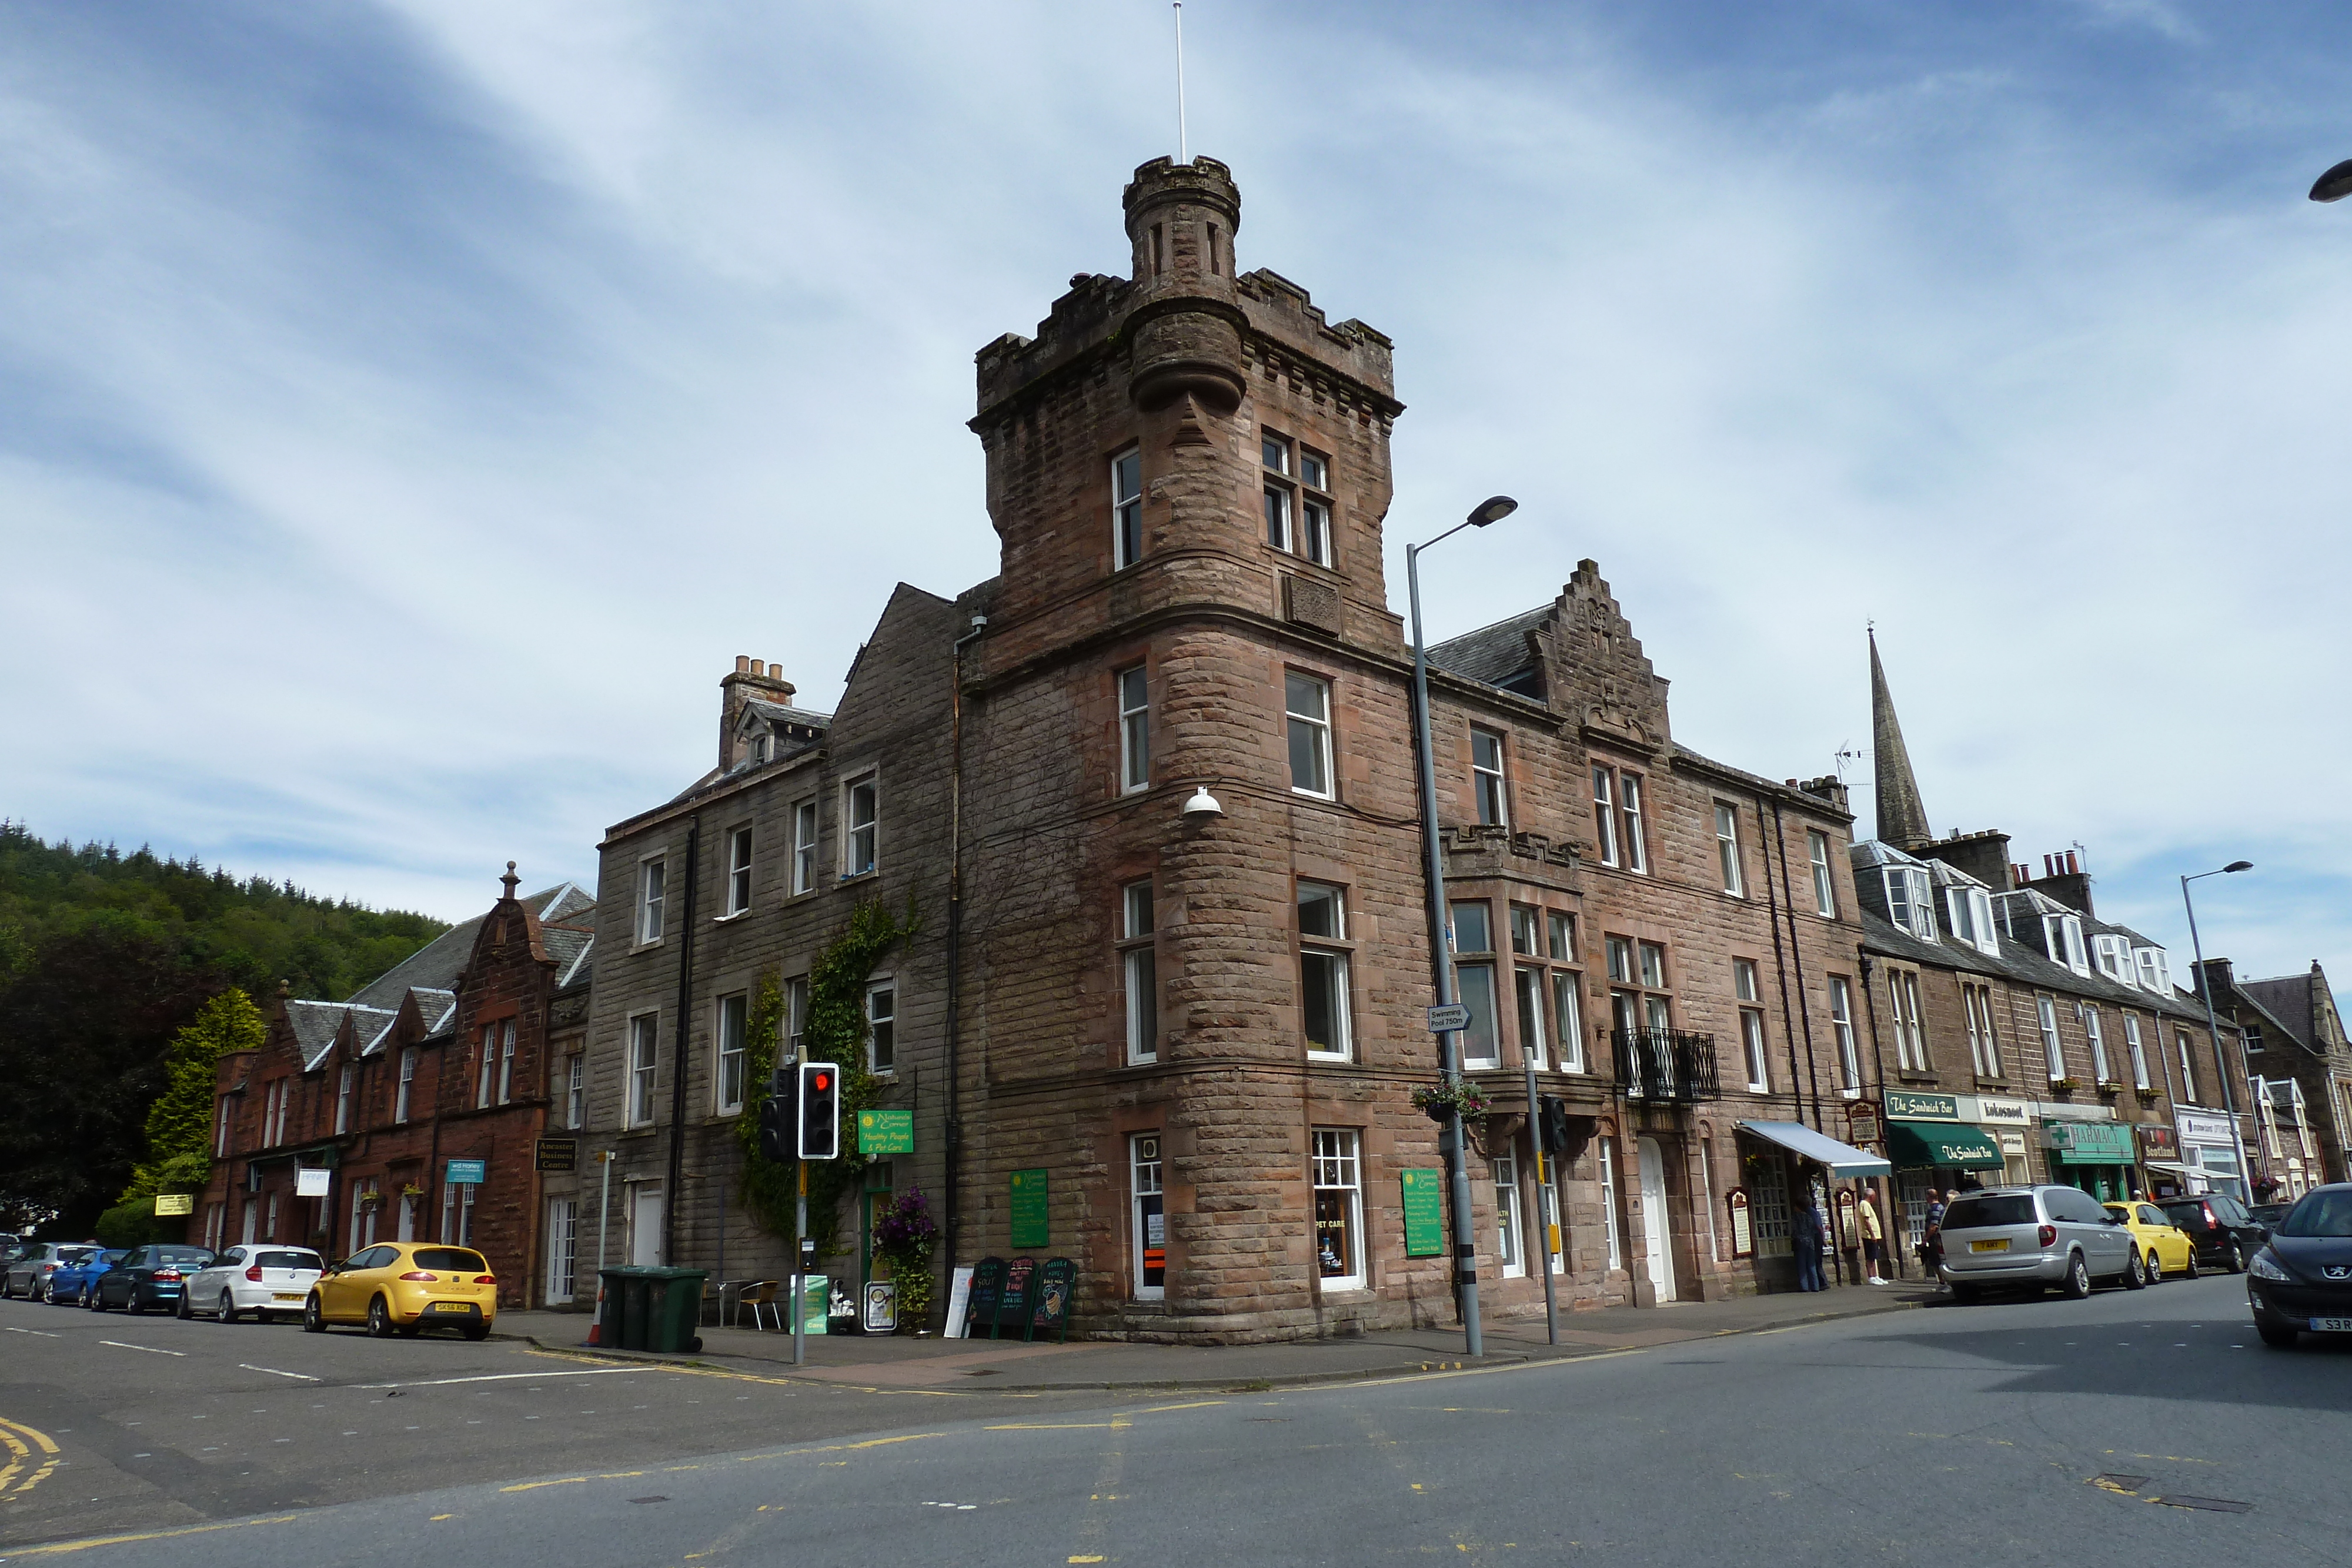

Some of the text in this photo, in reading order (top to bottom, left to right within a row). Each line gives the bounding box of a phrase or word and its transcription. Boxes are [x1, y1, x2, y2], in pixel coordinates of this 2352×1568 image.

[1432, 1009, 1461, 1018] Swimming
[1890, 1097, 1907, 1112] The
[1909, 1099, 1939, 1114] Sandwich
[1939, 1101, 1953, 1114] Bar
[880, 1121, 909, 1129] Corner
[890, 1132, 909, 1142] People
[2072, 1128, 2119, 1144] HARMACY
[2149, 1131, 2155, 1142] I
[876, 1143, 886, 1151] Pet
[2146, 1145, 2176, 1157] Scotland
[1942, 1145, 1992, 1161] The Sandwich Bar
[2326, 1319, 2352, 1329] S3 R
